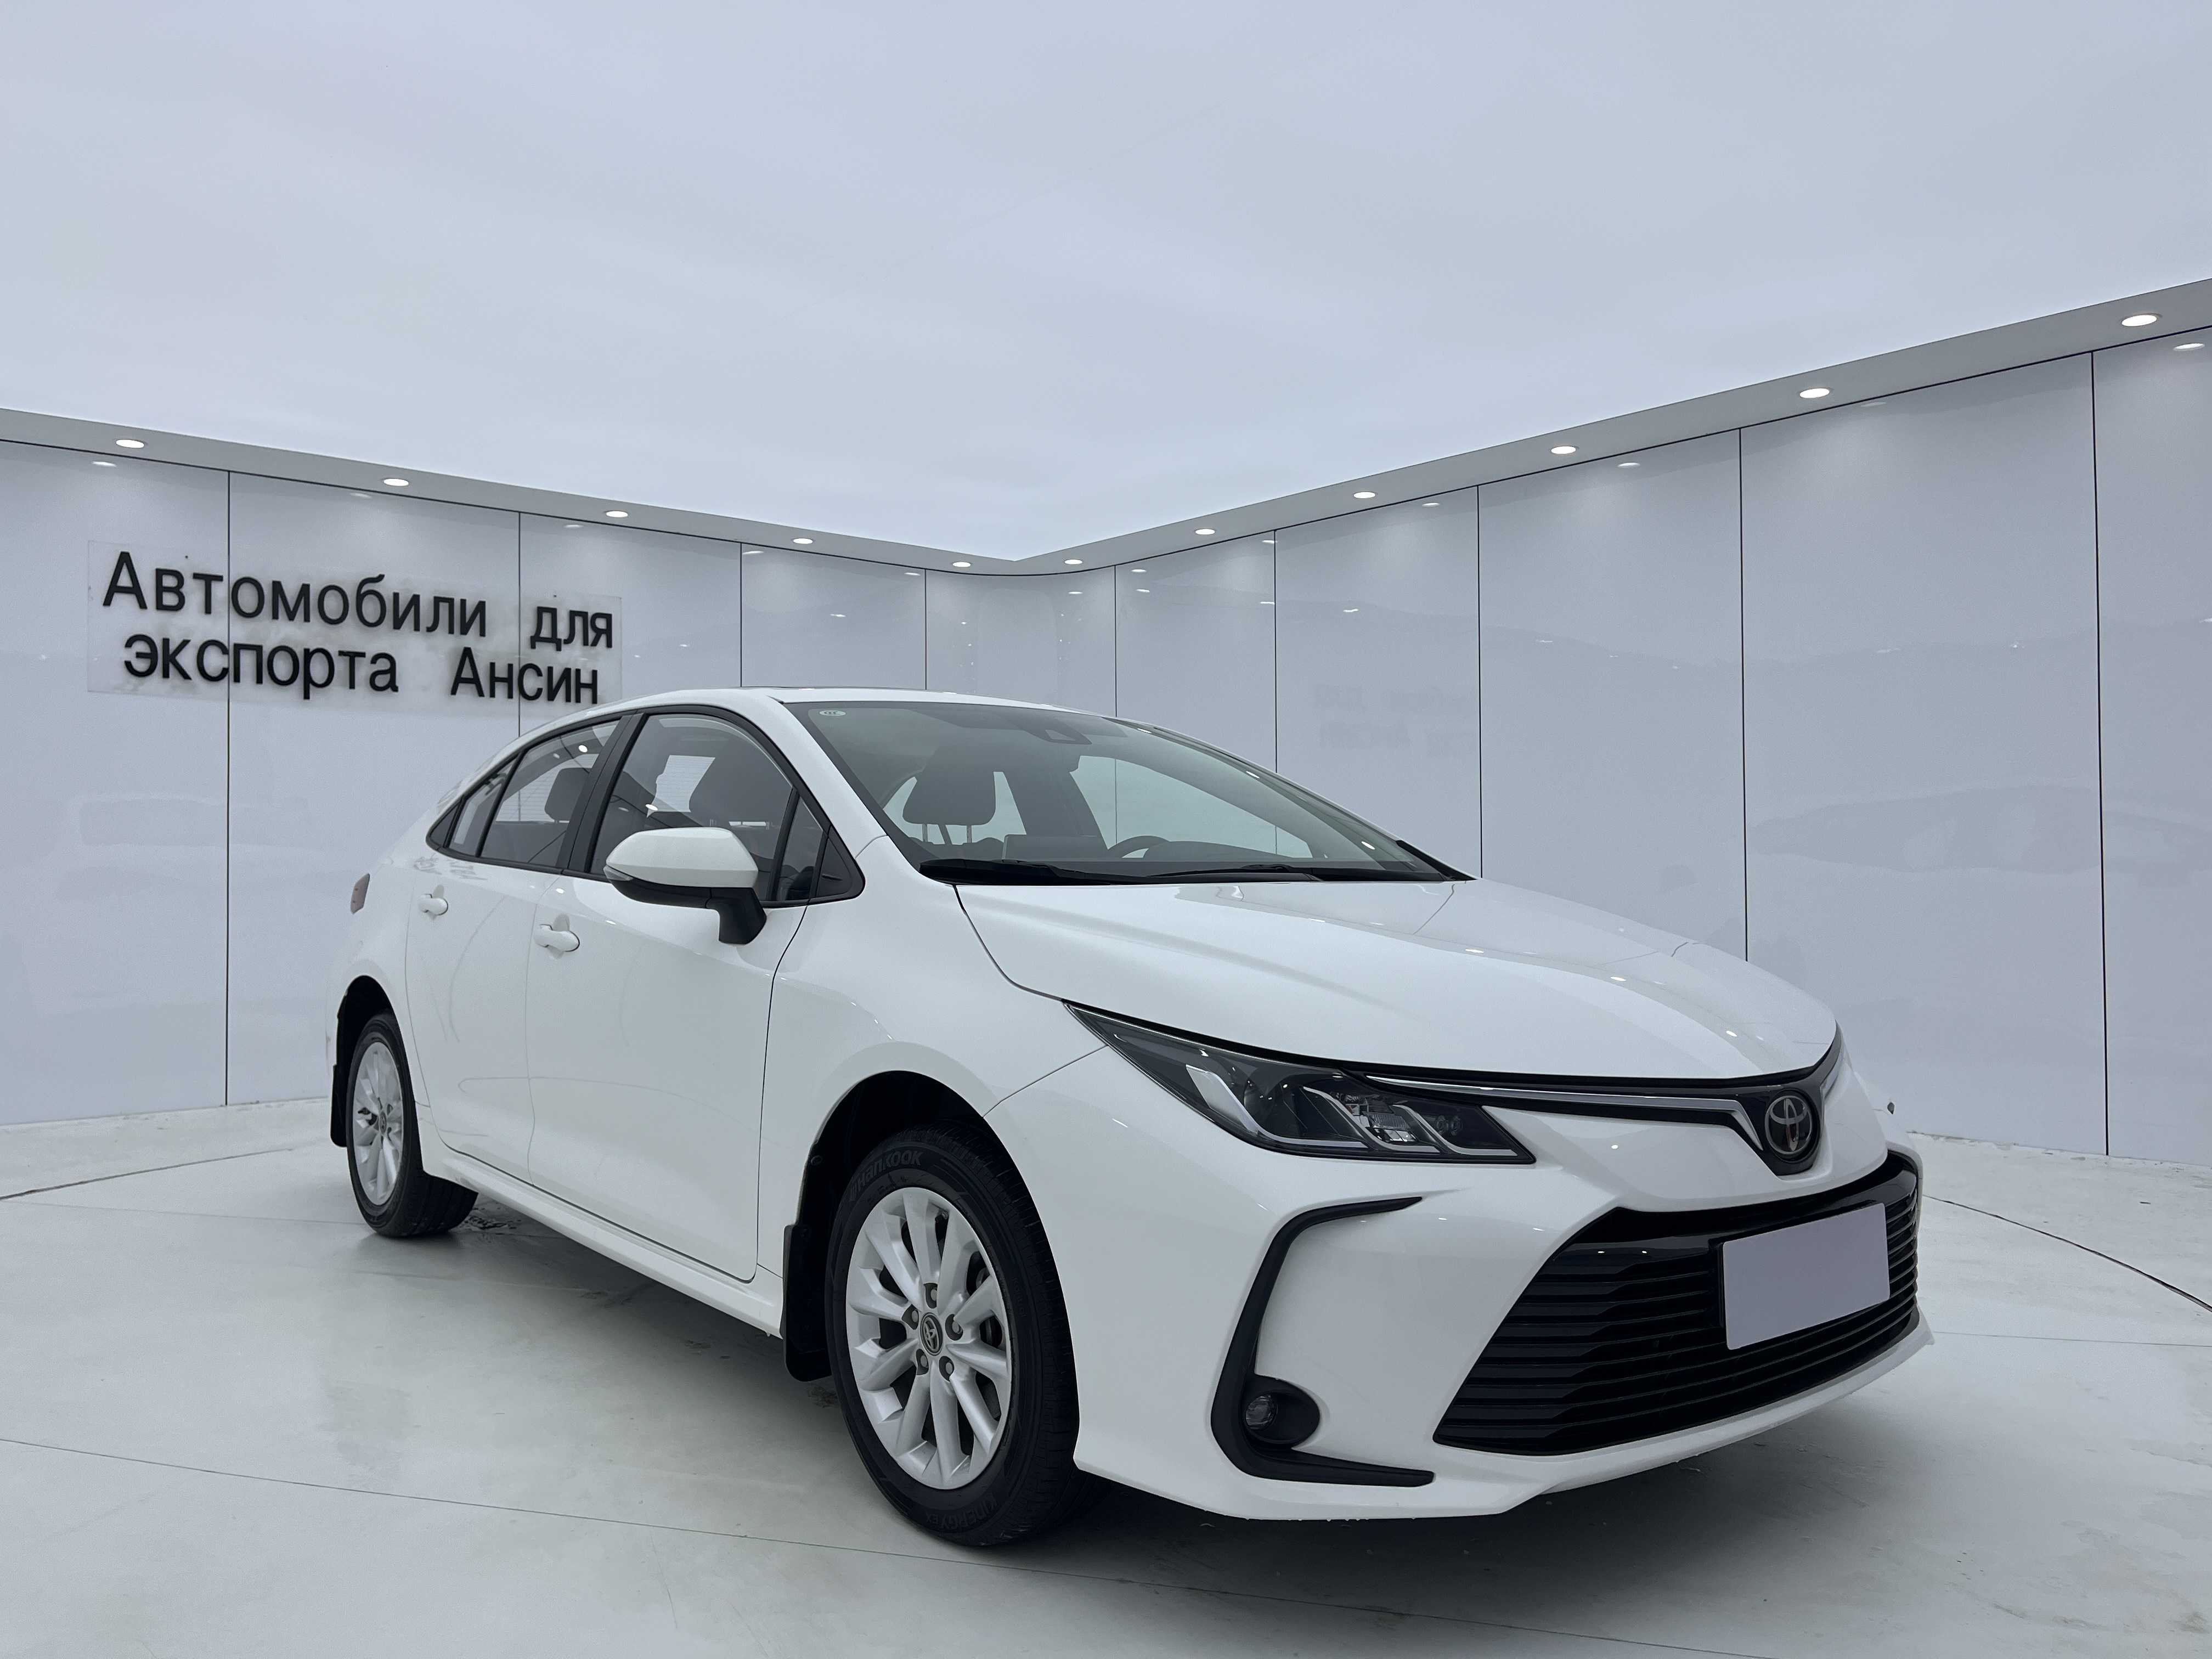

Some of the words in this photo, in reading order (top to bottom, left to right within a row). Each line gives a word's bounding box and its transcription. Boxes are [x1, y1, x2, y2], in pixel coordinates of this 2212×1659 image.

[103, 551, 487, 638] Автомобили
[530, 606, 613, 652] для
[124, 634, 399, 701] экспорта
[450, 646, 599, 704] Ансин
